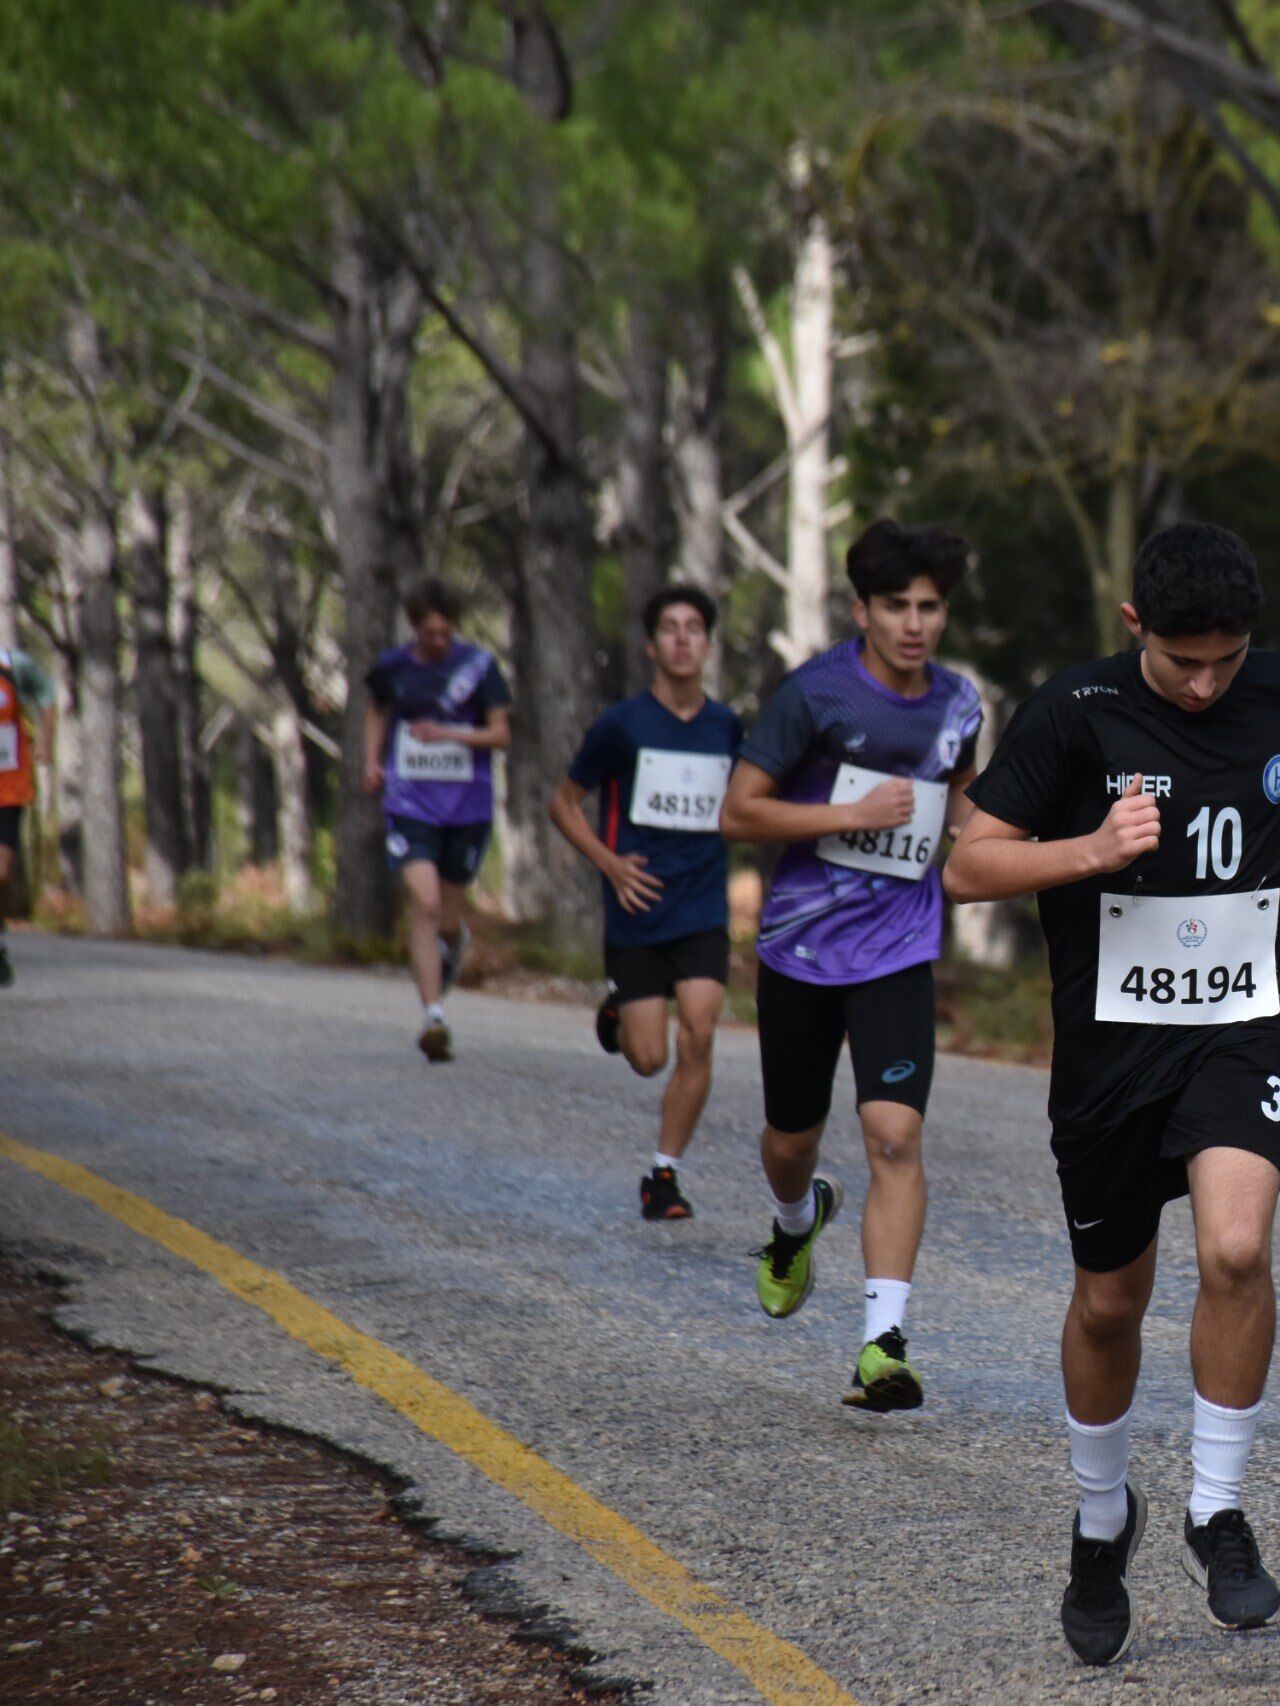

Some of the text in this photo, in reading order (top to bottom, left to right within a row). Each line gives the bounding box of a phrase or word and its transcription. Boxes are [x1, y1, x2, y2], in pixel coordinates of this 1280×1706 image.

[647, 792, 717, 818] 48157
[839, 828, 931, 865] 48116
[1187, 806, 1242, 880] 10
[1120, 961, 1257, 1005] 48194
